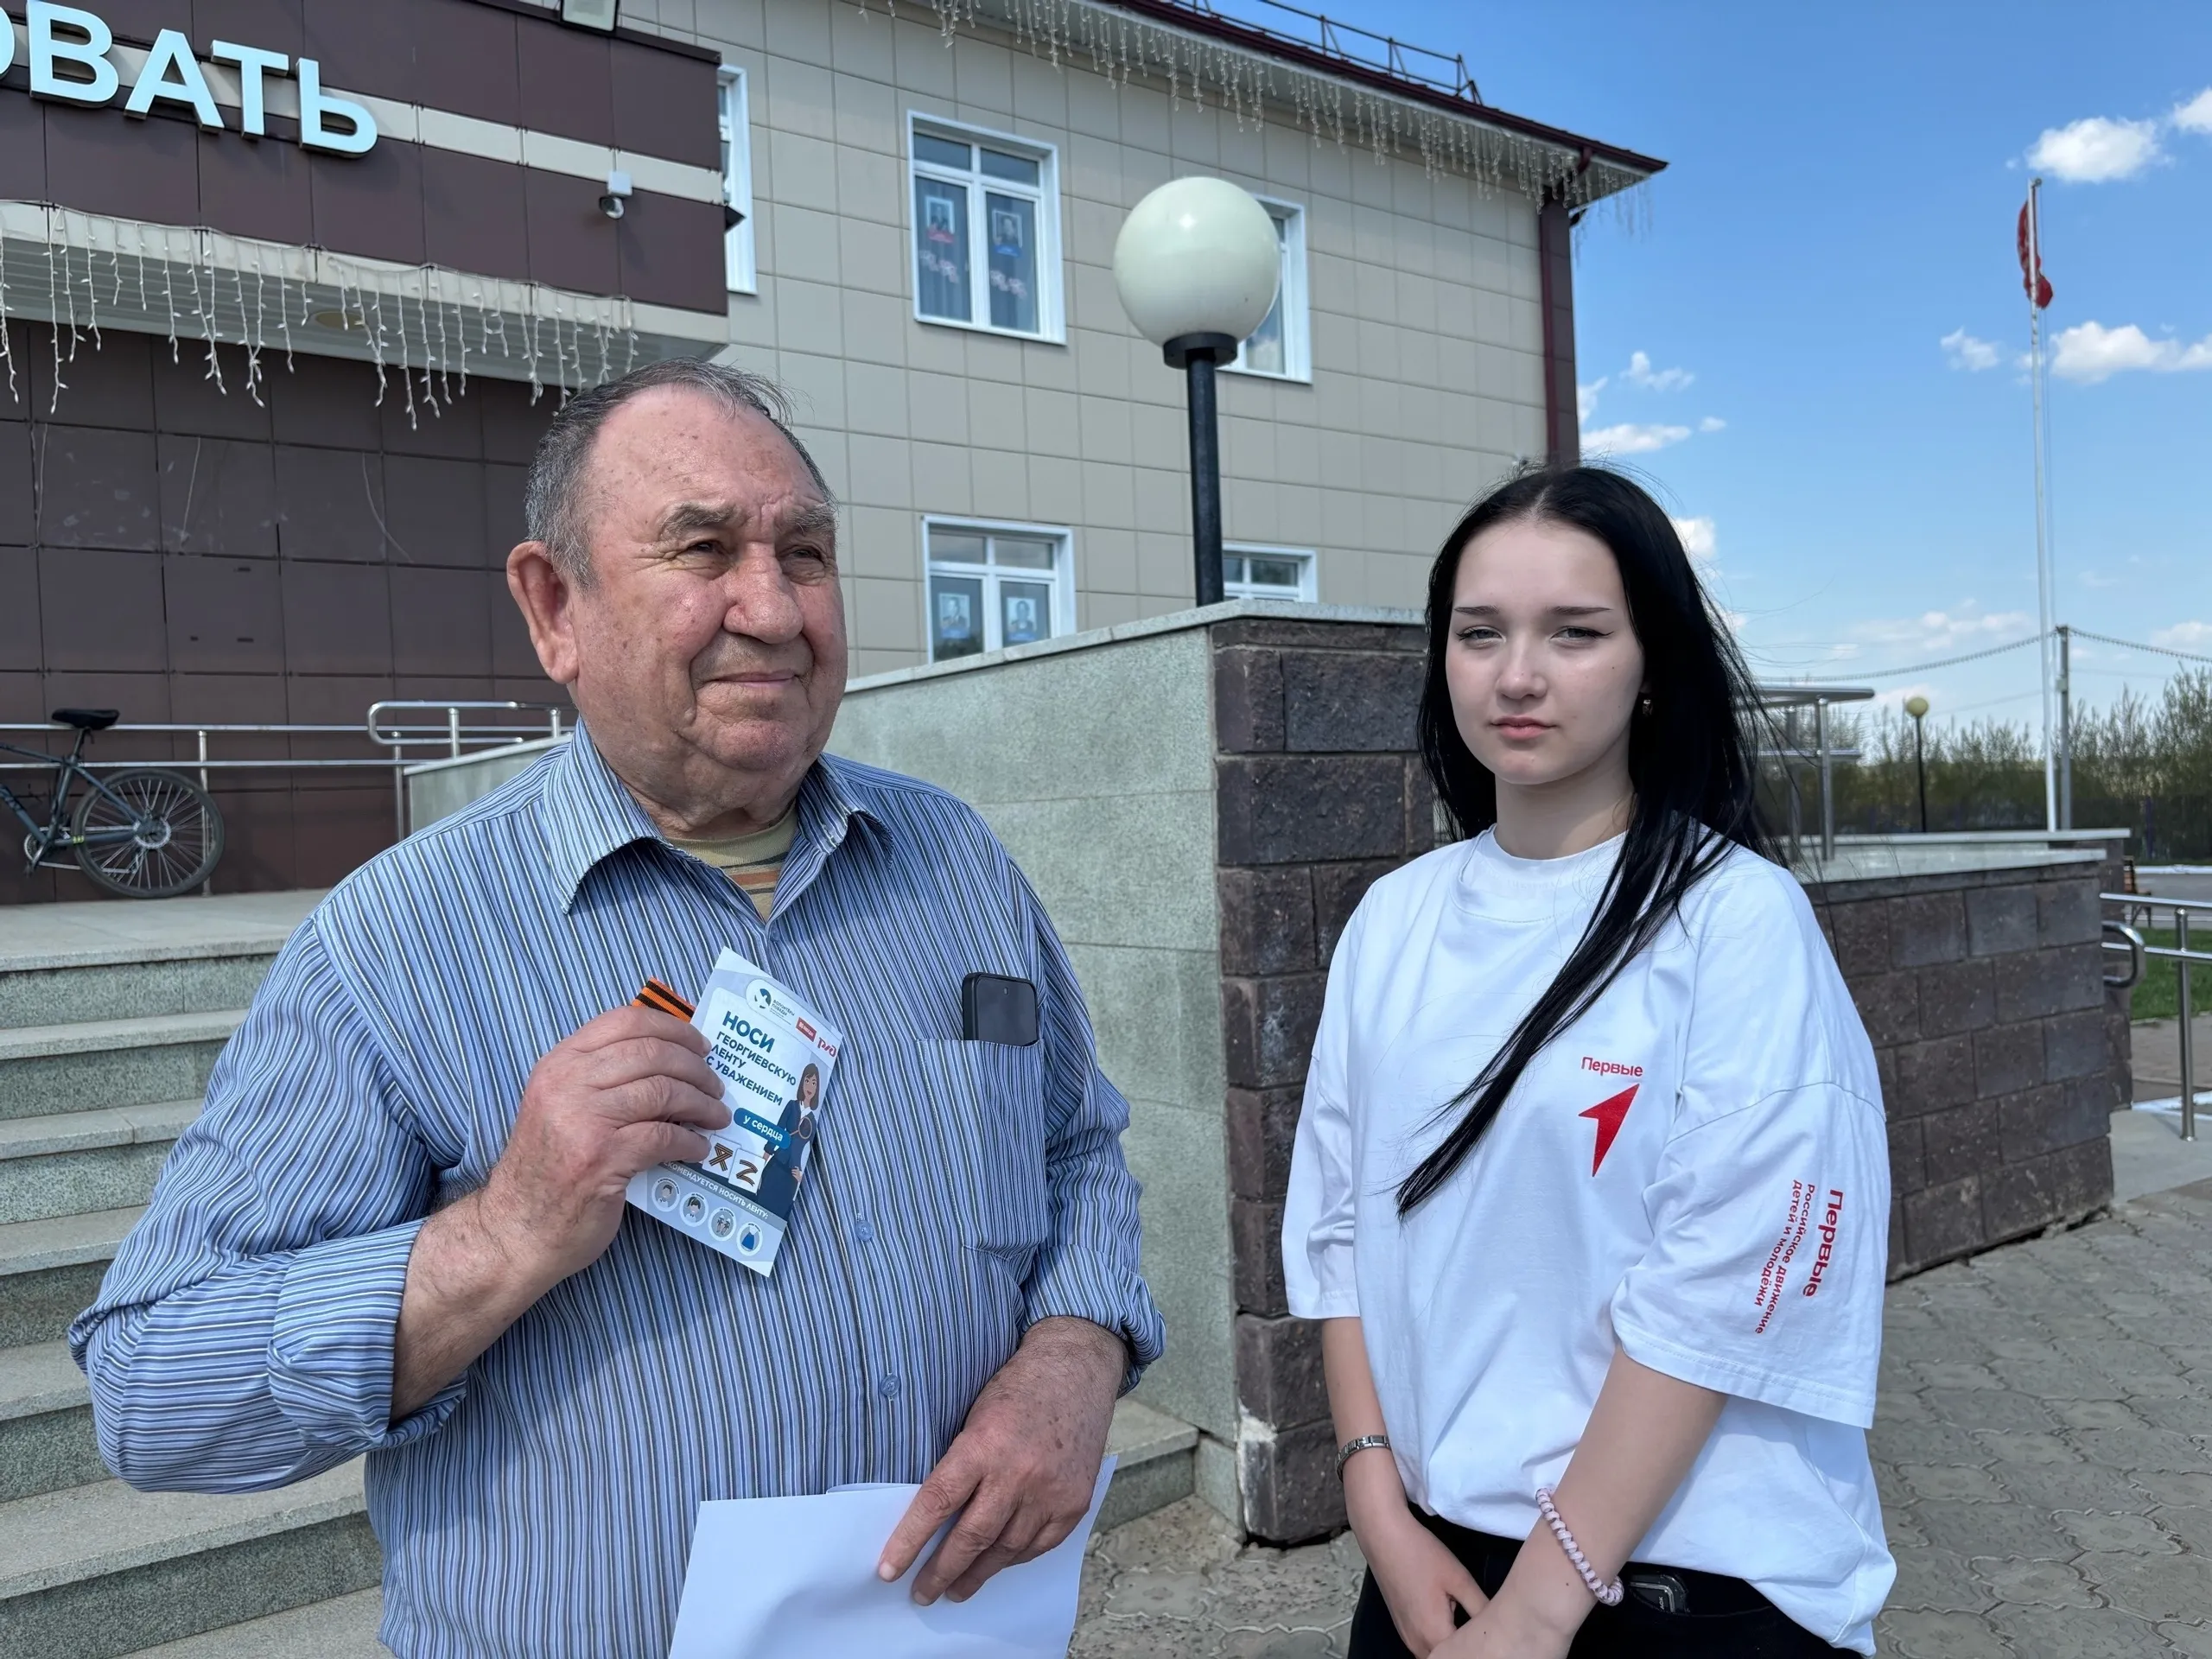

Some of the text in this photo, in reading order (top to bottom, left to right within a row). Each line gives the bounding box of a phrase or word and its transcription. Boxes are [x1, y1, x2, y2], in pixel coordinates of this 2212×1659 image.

[711, 1044, 747, 1069] ЛЕНТУ
[722, 1011, 776, 1053] НОСИ
[706, 1056, 783, 1106] С УВАЖЕНИЕМ
[716, 1031, 797, 1086] ГЕОРГИЕВСКУЮ
[1581, 1056, 1643, 1077] Первые
[743, 1115, 784, 1142] у сердца
[661, 1159, 719, 1192] ЕКОМЕНДУЕТСЯ
[719, 1187, 747, 1207] НОСИТЬ
[1754, 1179, 1803, 1306] детей и молодёжи
[1755, 1184, 1815, 1334] Российское движение
[1802, 1189, 1844, 1297] Первые
